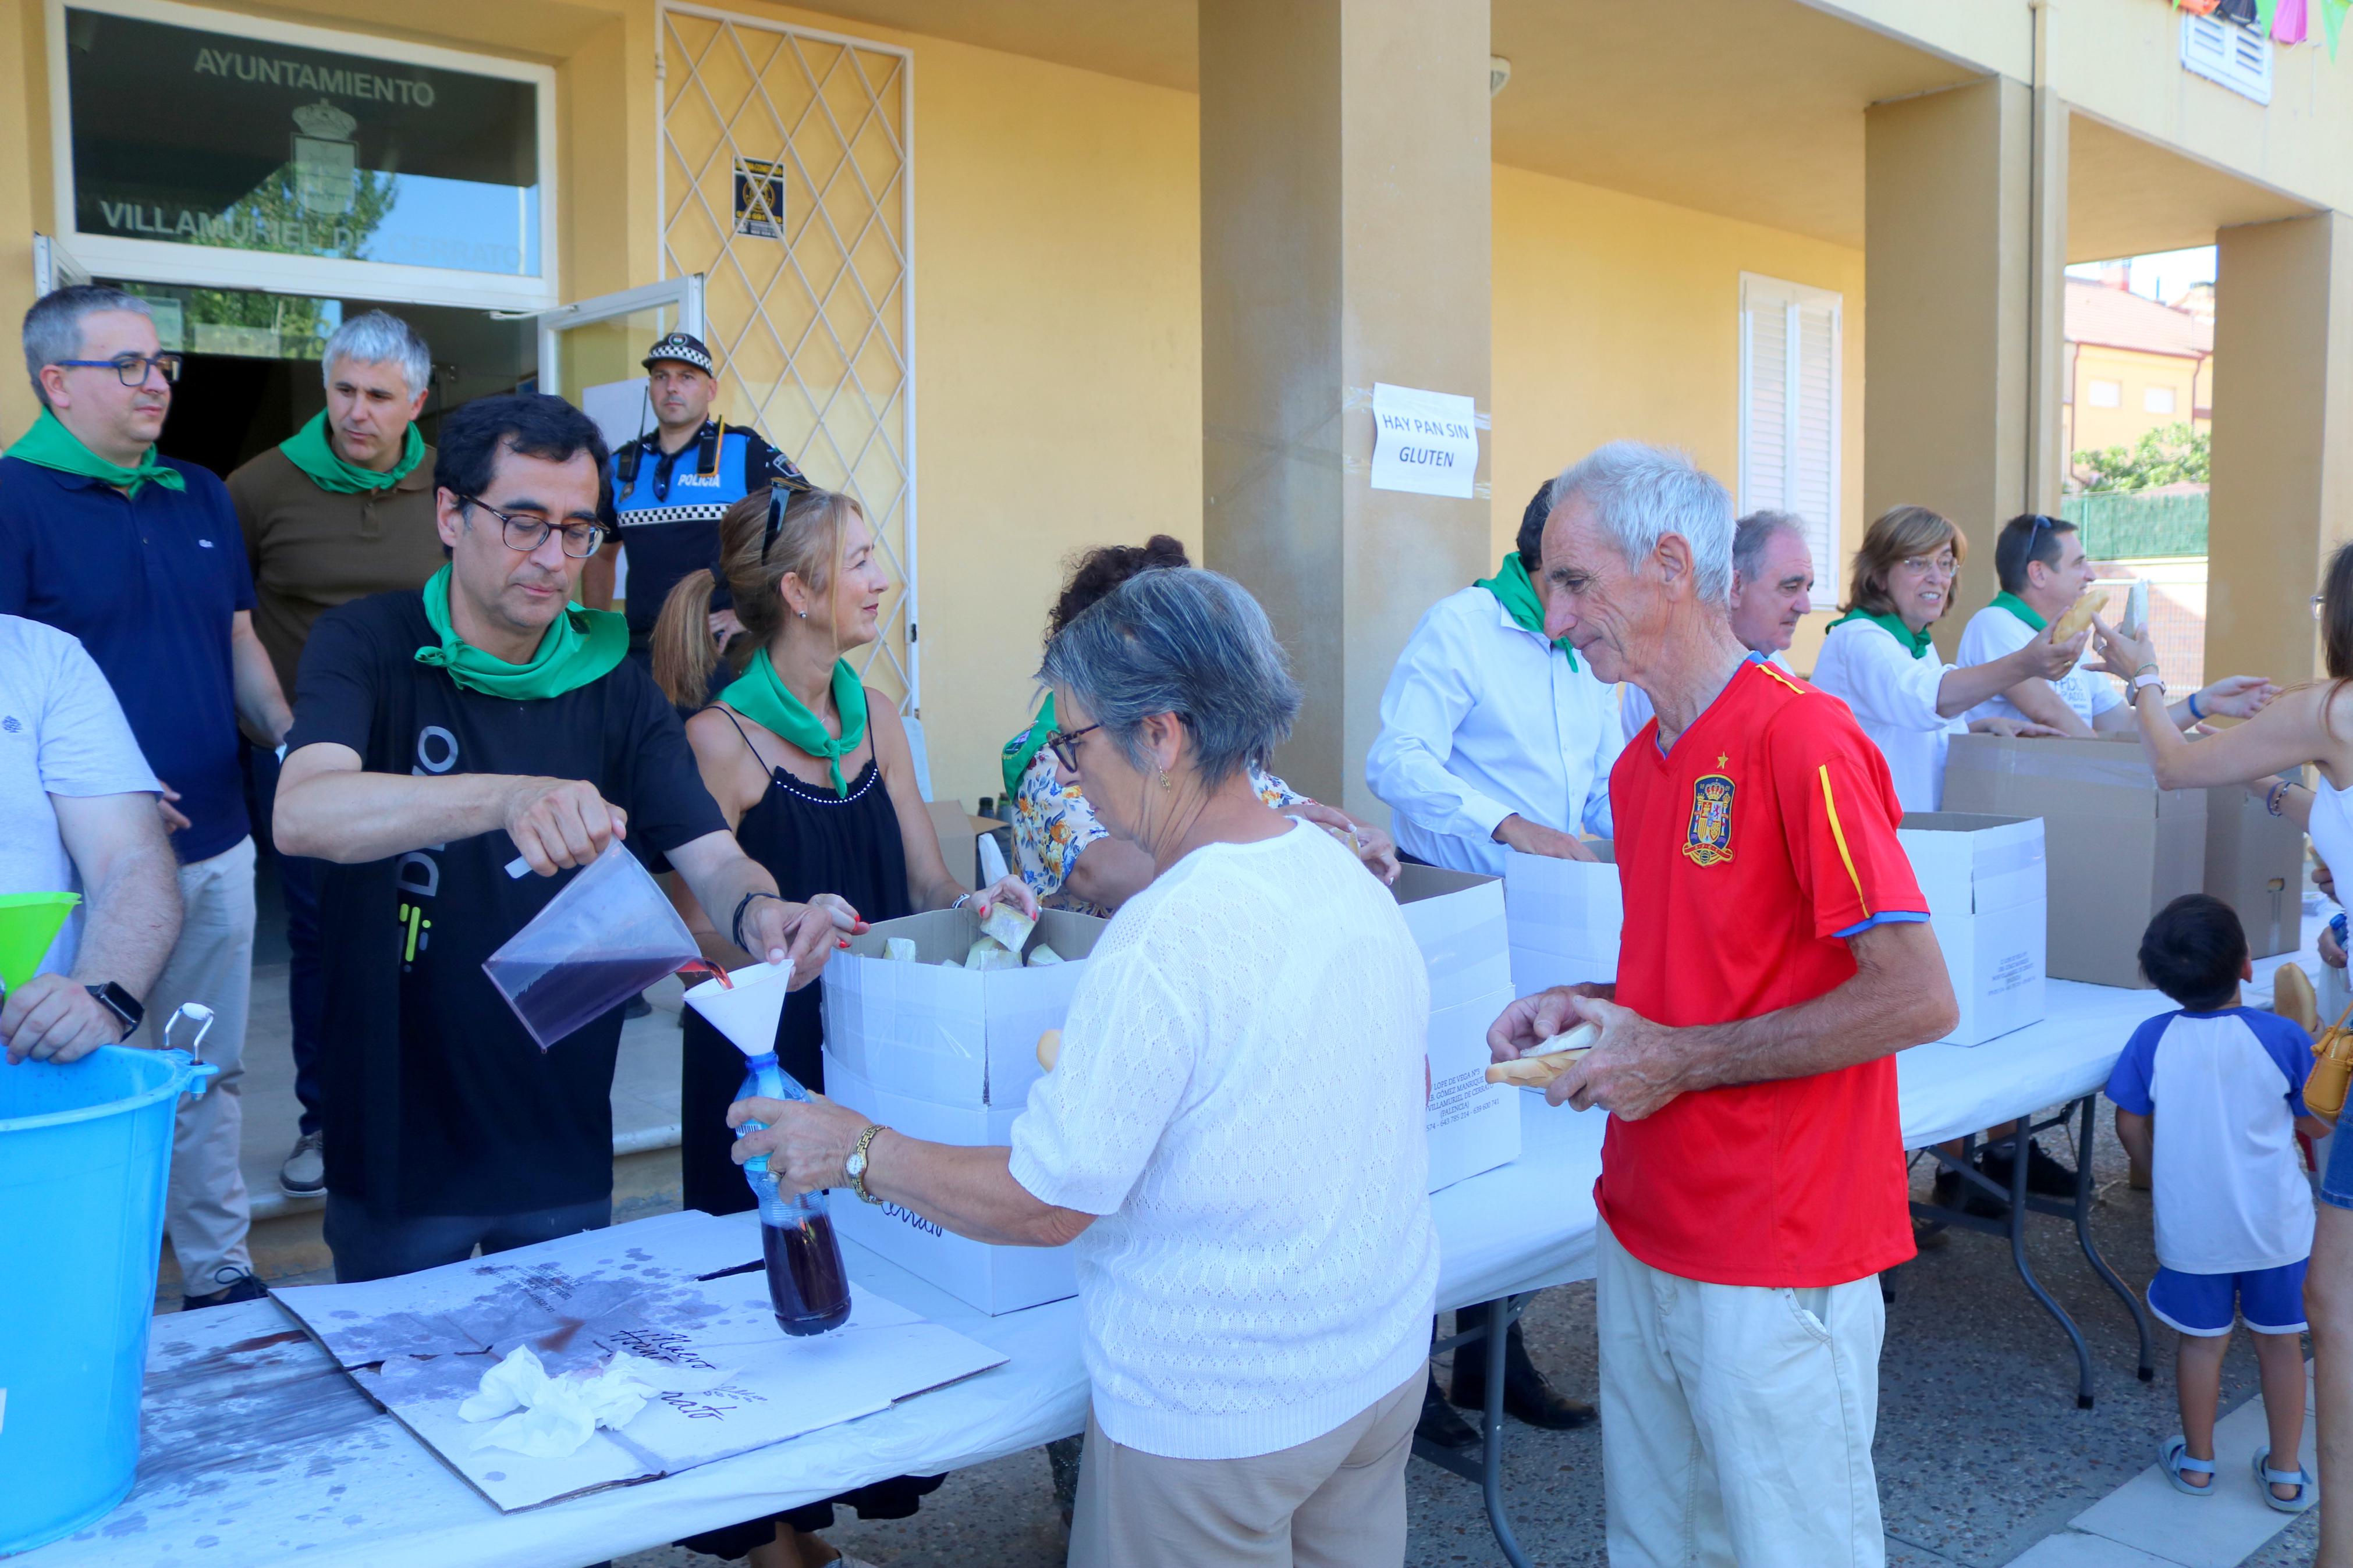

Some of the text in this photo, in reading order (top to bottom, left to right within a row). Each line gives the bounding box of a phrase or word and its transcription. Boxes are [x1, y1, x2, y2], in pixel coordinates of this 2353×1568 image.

[194, 48, 435, 108] AYUNTAMIENTO
[100, 201, 318, 250] VILLAMURIEL
[1382, 414, 1470, 439] HAY PAN SIN
[1399, 446, 1454, 467] GLUTEN
[1433, 1080, 1447, 1090] LOPE
[1449, 1077, 1456, 1086] DE
[1457, 1072, 1471, 1082] VEGA
[1457, 1076, 1485, 1092] MANRIQUE
[1464, 1090, 1471, 1099] DE
[1440, 1101, 1470, 1118] (PALENCIA)
